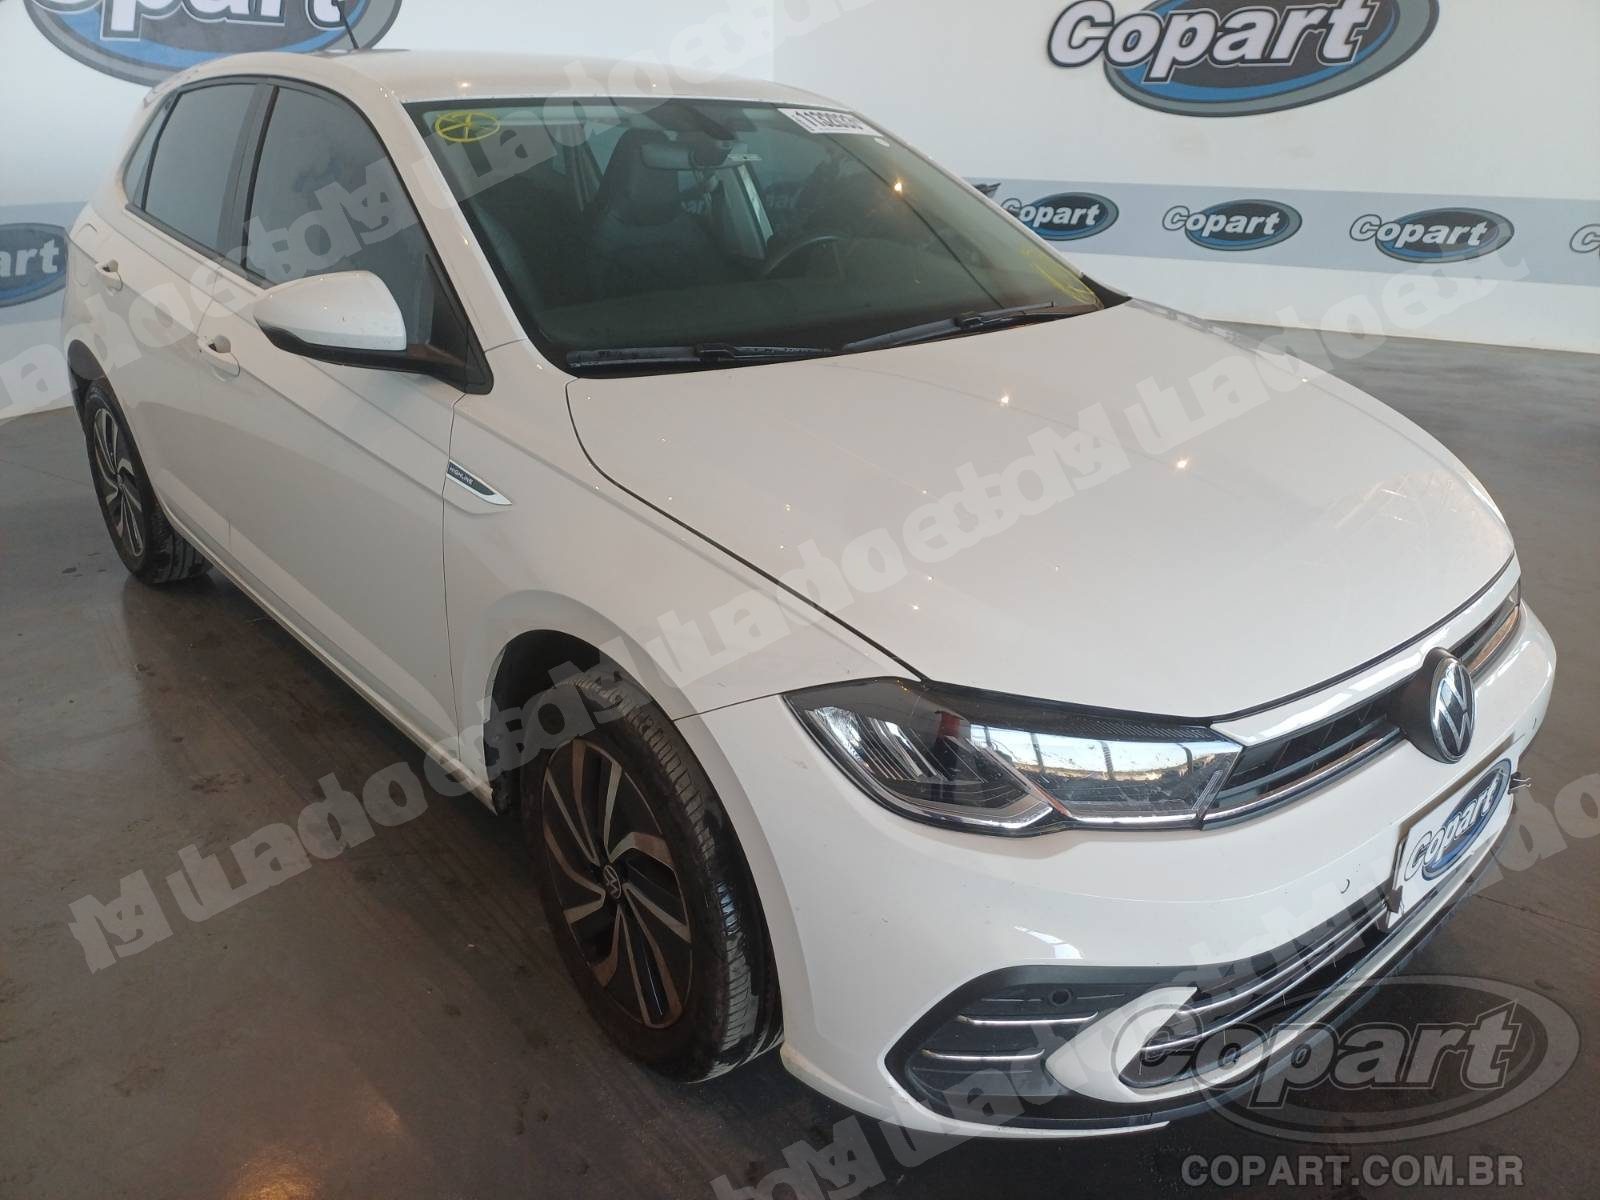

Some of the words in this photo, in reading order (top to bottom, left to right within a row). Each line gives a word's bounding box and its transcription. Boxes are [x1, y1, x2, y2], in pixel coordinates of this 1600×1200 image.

[1048, 0, 1377, 83] Copart
[1163, 205, 1281, 237] Copart
[1350, 213, 1488, 248] Copart
[1405, 766, 1506, 882] Copart
